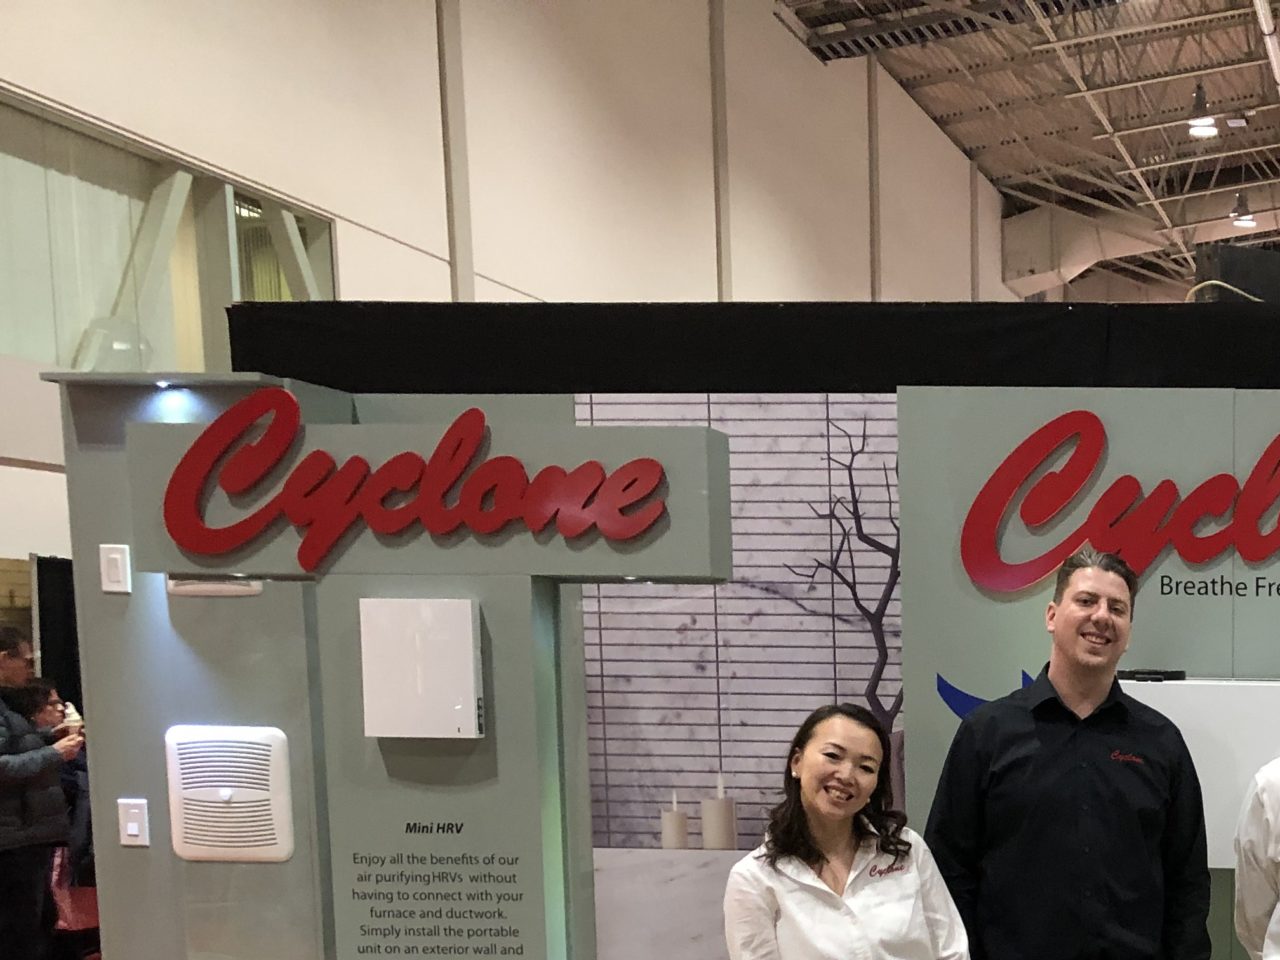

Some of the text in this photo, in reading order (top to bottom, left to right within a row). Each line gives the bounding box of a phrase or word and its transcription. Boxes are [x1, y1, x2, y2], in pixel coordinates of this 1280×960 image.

[163, 388, 667, 572] Cyclone
[1160, 575, 1249, 597] Breathe
[405, 823, 464, 834] Mini HRV
[353, 853, 520, 867] Enjoy all the benefits of our
[357, 871, 517, 886] air purifying HRVs without
[352, 889, 524, 904] having to connect with your
[370, 907, 508, 920] furnace and ductwork.
[360, 925, 520, 939] Simply install the portable
[357, 943, 524, 955] unit on an exterior wall and
